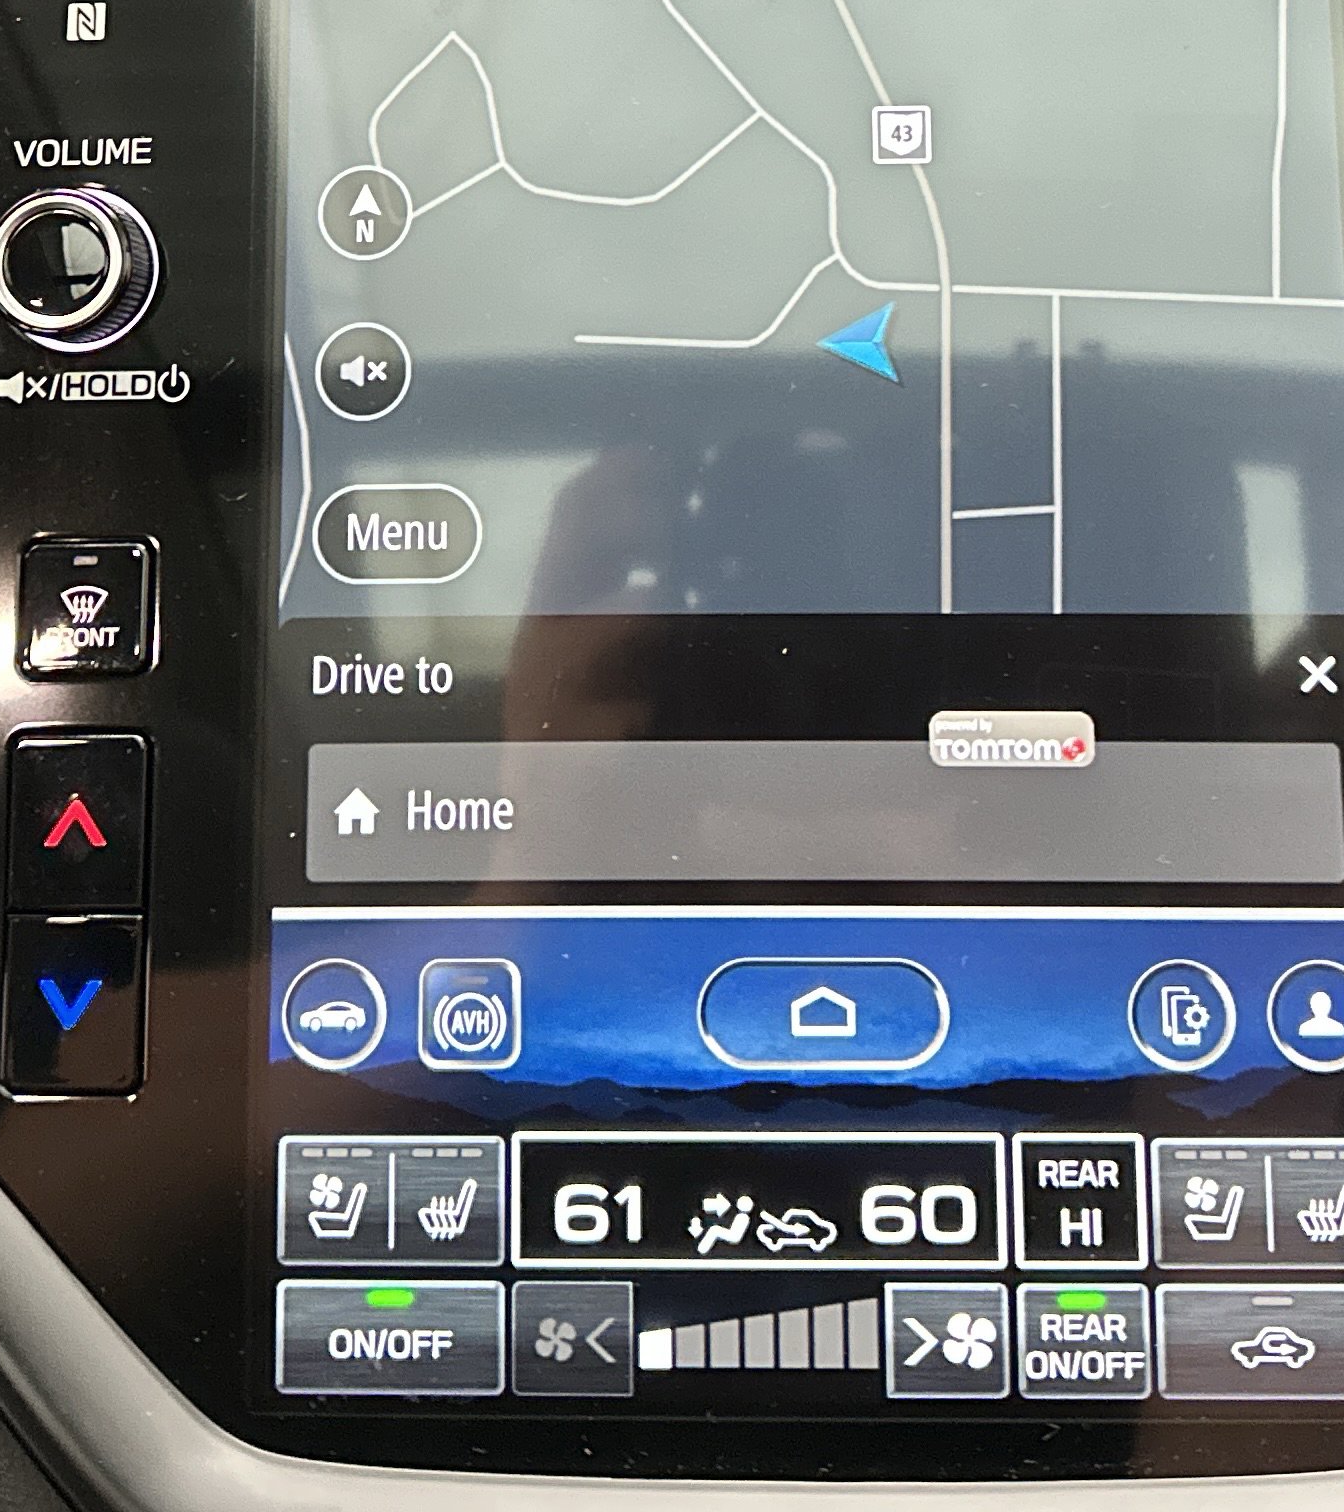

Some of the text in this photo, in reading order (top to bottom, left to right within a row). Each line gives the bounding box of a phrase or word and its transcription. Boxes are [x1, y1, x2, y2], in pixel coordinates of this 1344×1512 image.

[891, 124, 913, 142] 43
[13, 137, 153, 167] VOLUME
[356, 219, 374, 243] N
[346, 513, 448, 551] Menu
[312, 653, 453, 695] Drive to
[407, 789, 514, 831] Home
[451, 1009, 490, 1036] AVH
[1038, 1159, 1120, 1189] REAR
[554, 1183, 977, 1245] 61 60
[1060, 1207, 1103, 1247] HI
[1040, 1313, 1127, 1342] REAR
[329, 1329, 453, 1361] ON/OFF
[1025, 1349, 1146, 1381] ON/OFF
